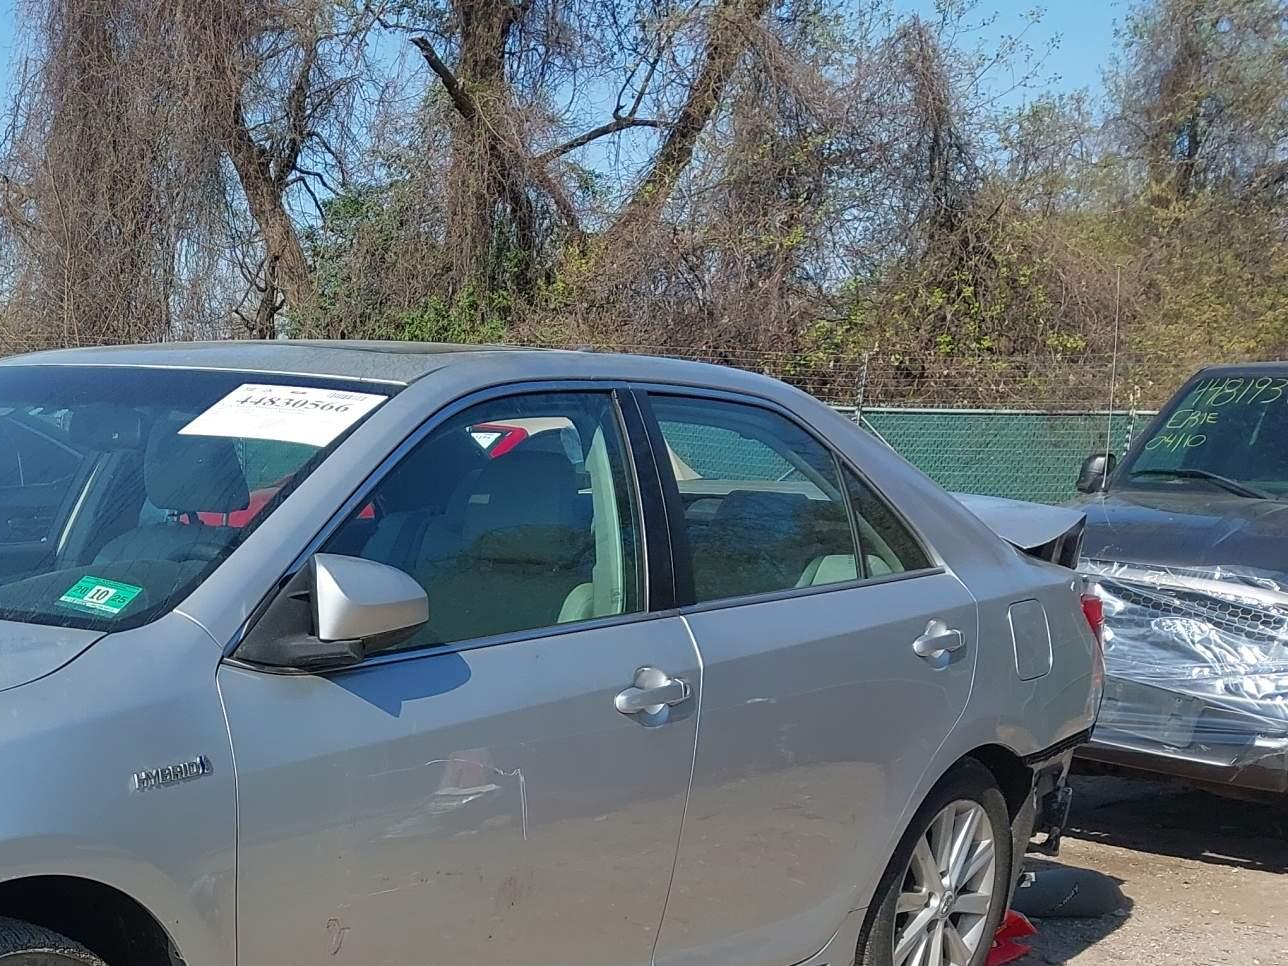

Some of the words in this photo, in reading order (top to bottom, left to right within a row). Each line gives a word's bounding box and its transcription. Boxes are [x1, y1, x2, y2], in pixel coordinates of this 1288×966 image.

[1192, 376, 1288, 407] 448193
[236, 395, 351, 413] 44830566
[1166, 408, 1220, 429] ERIE
[88, 588, 110, 601] 10
[111, 593, 129, 604] 25
[133, 761, 201, 791] HYBRID
